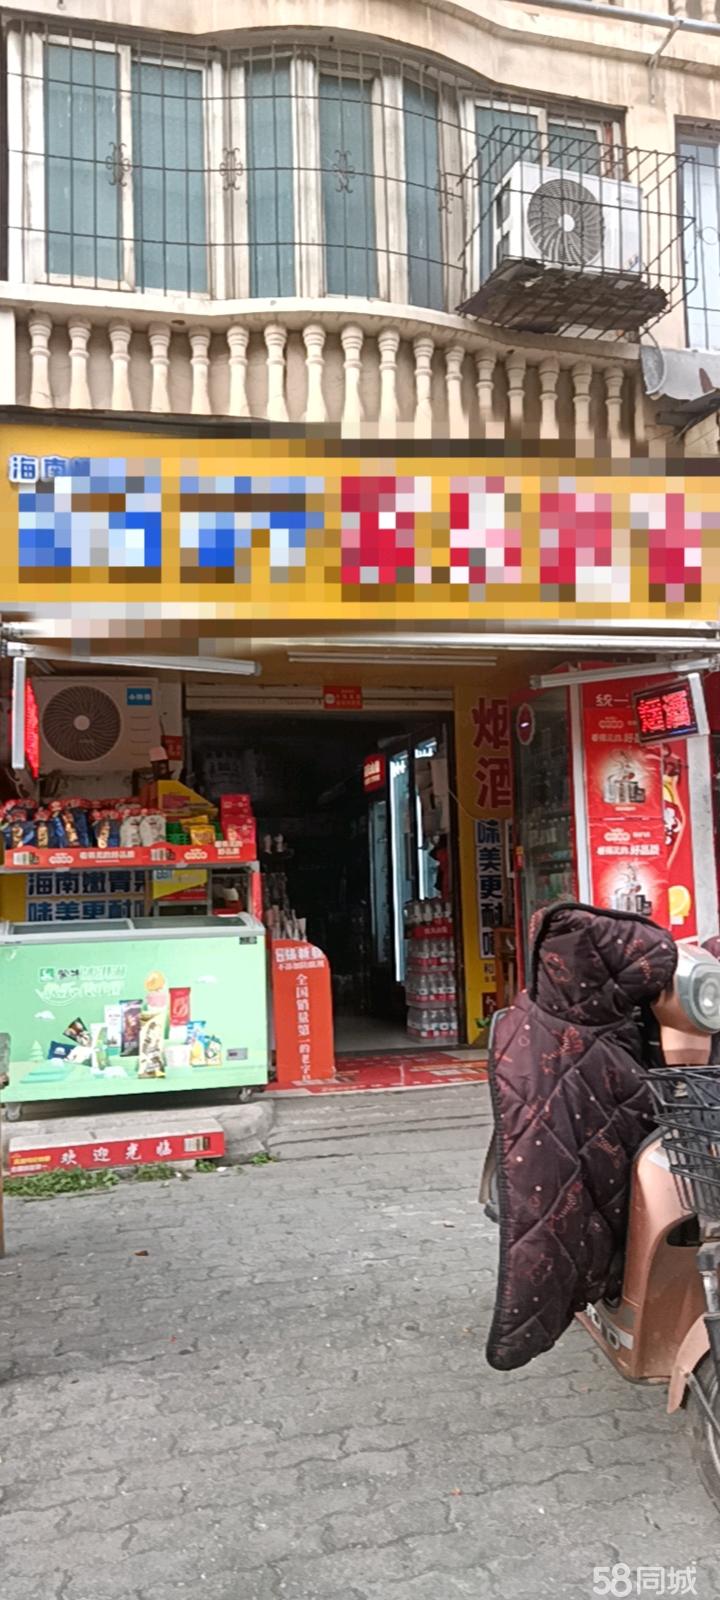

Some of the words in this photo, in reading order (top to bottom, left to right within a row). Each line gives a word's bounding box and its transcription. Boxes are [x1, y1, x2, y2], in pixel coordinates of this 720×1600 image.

[595, 694, 629, 707] 统一
[472, 697, 512, 808] 烟酒
[60, 1139, 172, 1165] 欢迎光临
